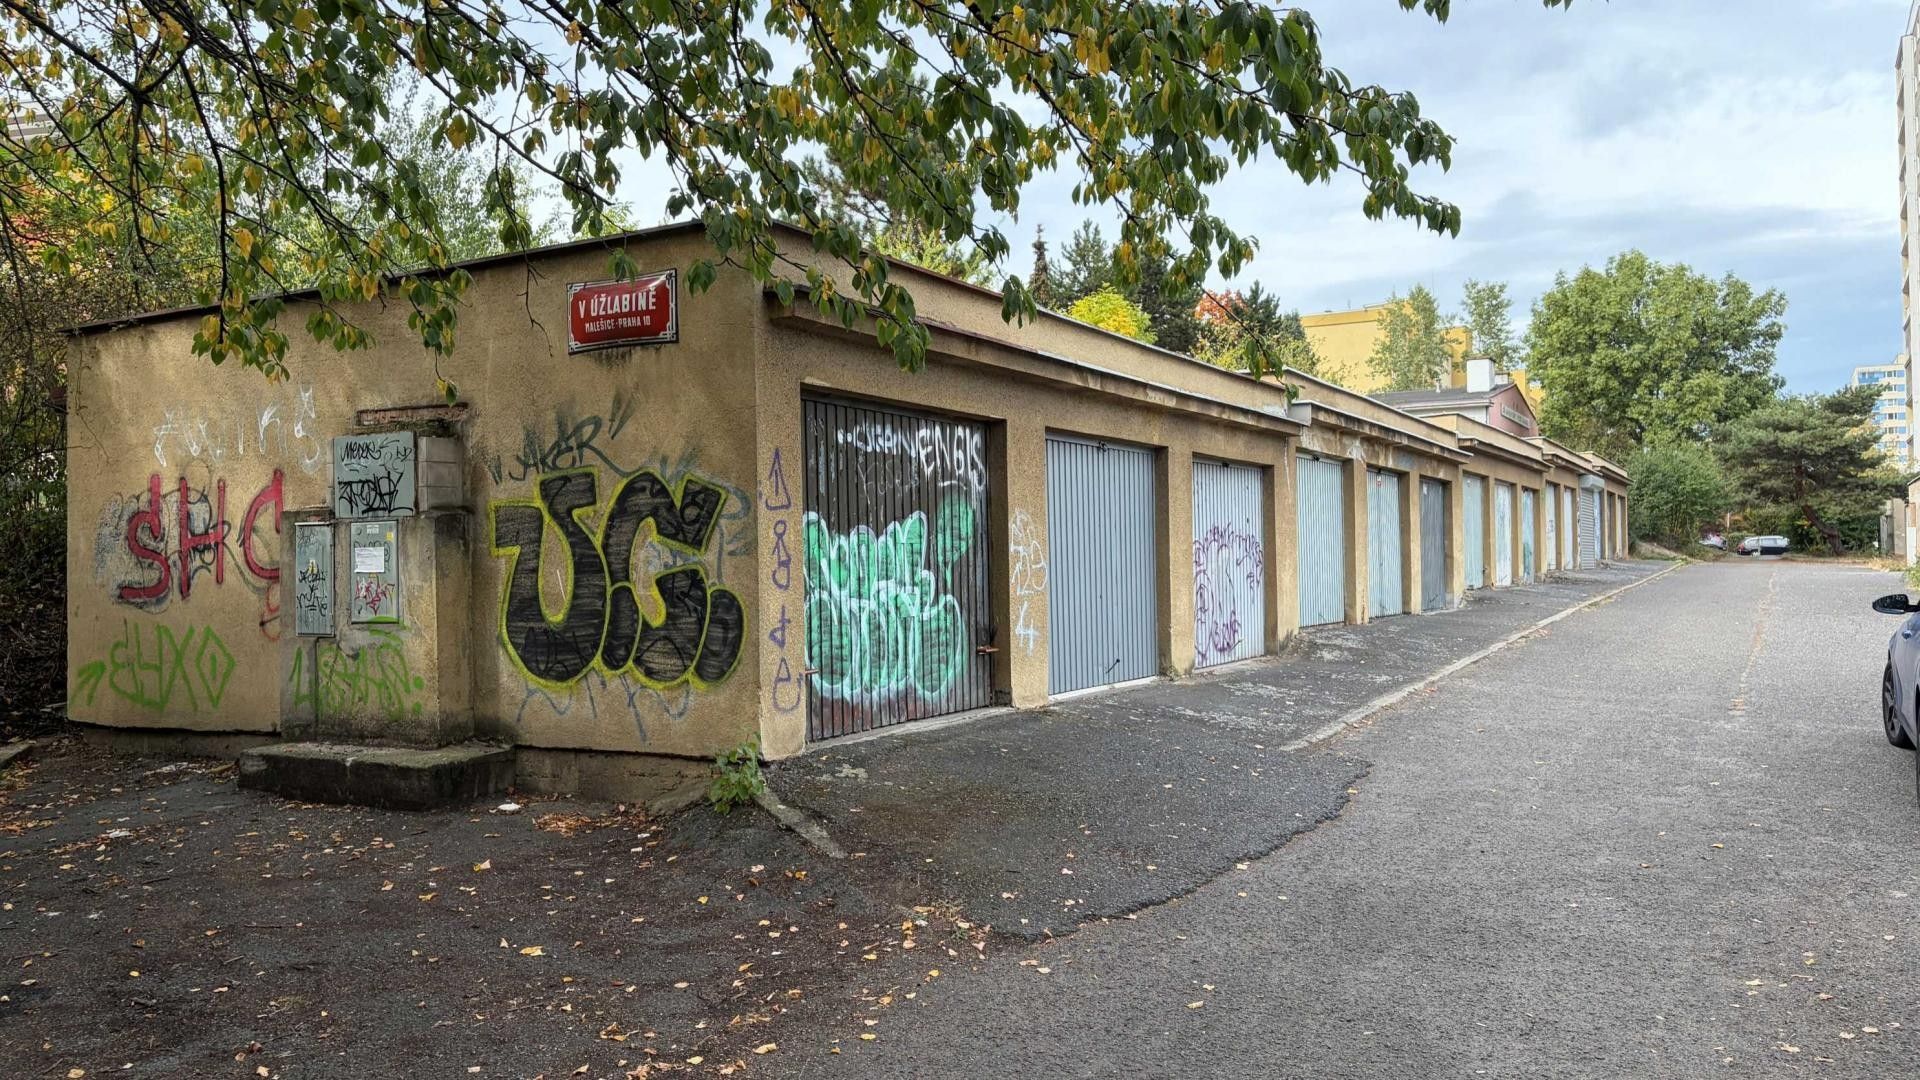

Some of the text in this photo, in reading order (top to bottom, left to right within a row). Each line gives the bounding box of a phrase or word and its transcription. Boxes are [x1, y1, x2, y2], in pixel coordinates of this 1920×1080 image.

[579, 286, 656, 318] V ÚŽLABINĚ
[643, 316, 651, 326] 10
